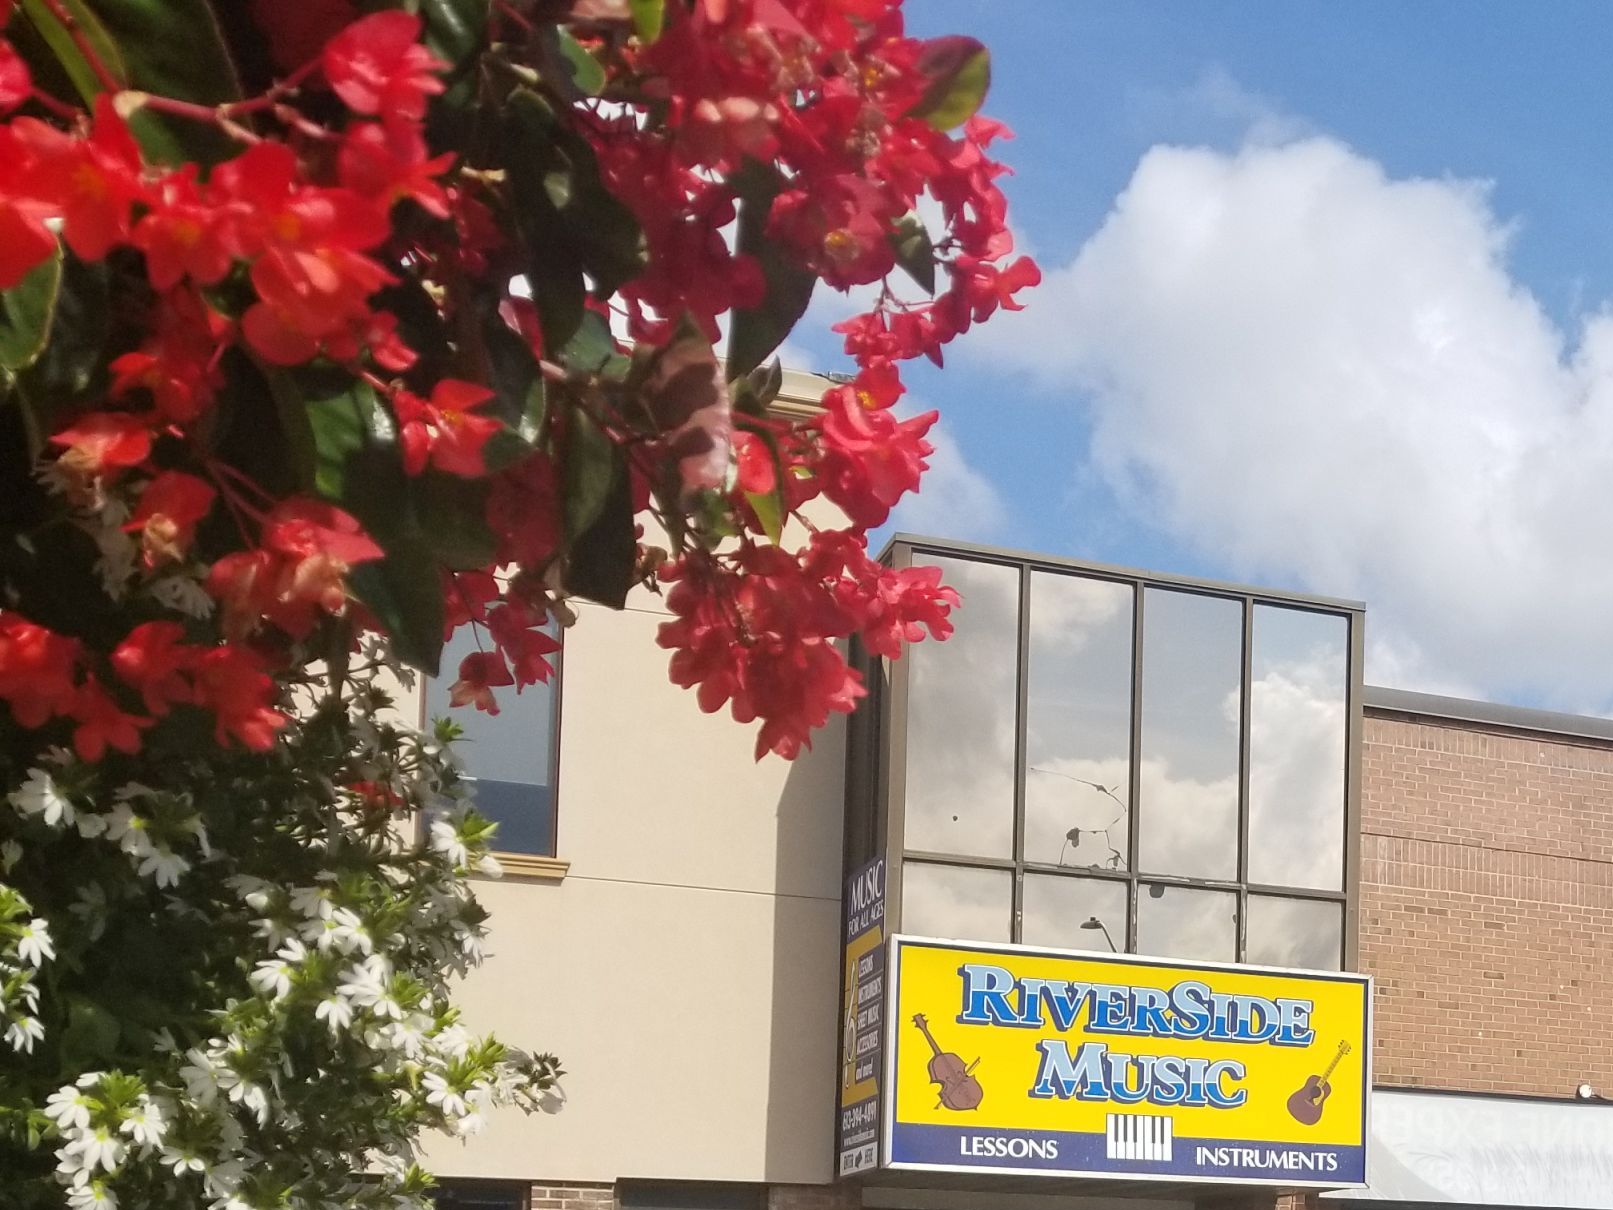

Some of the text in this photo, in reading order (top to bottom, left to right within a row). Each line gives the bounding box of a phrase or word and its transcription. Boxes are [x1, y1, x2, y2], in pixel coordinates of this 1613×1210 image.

[851, 860, 883, 915] MUSIC
[848, 899, 884, 936] FOR ALL AGES
[956, 963, 1316, 1048] RIVERSIDE
[1027, 1038, 1249, 1110] MUSIC
[960, 1135, 1338, 1172] LESSONS INSTRUMENTS
